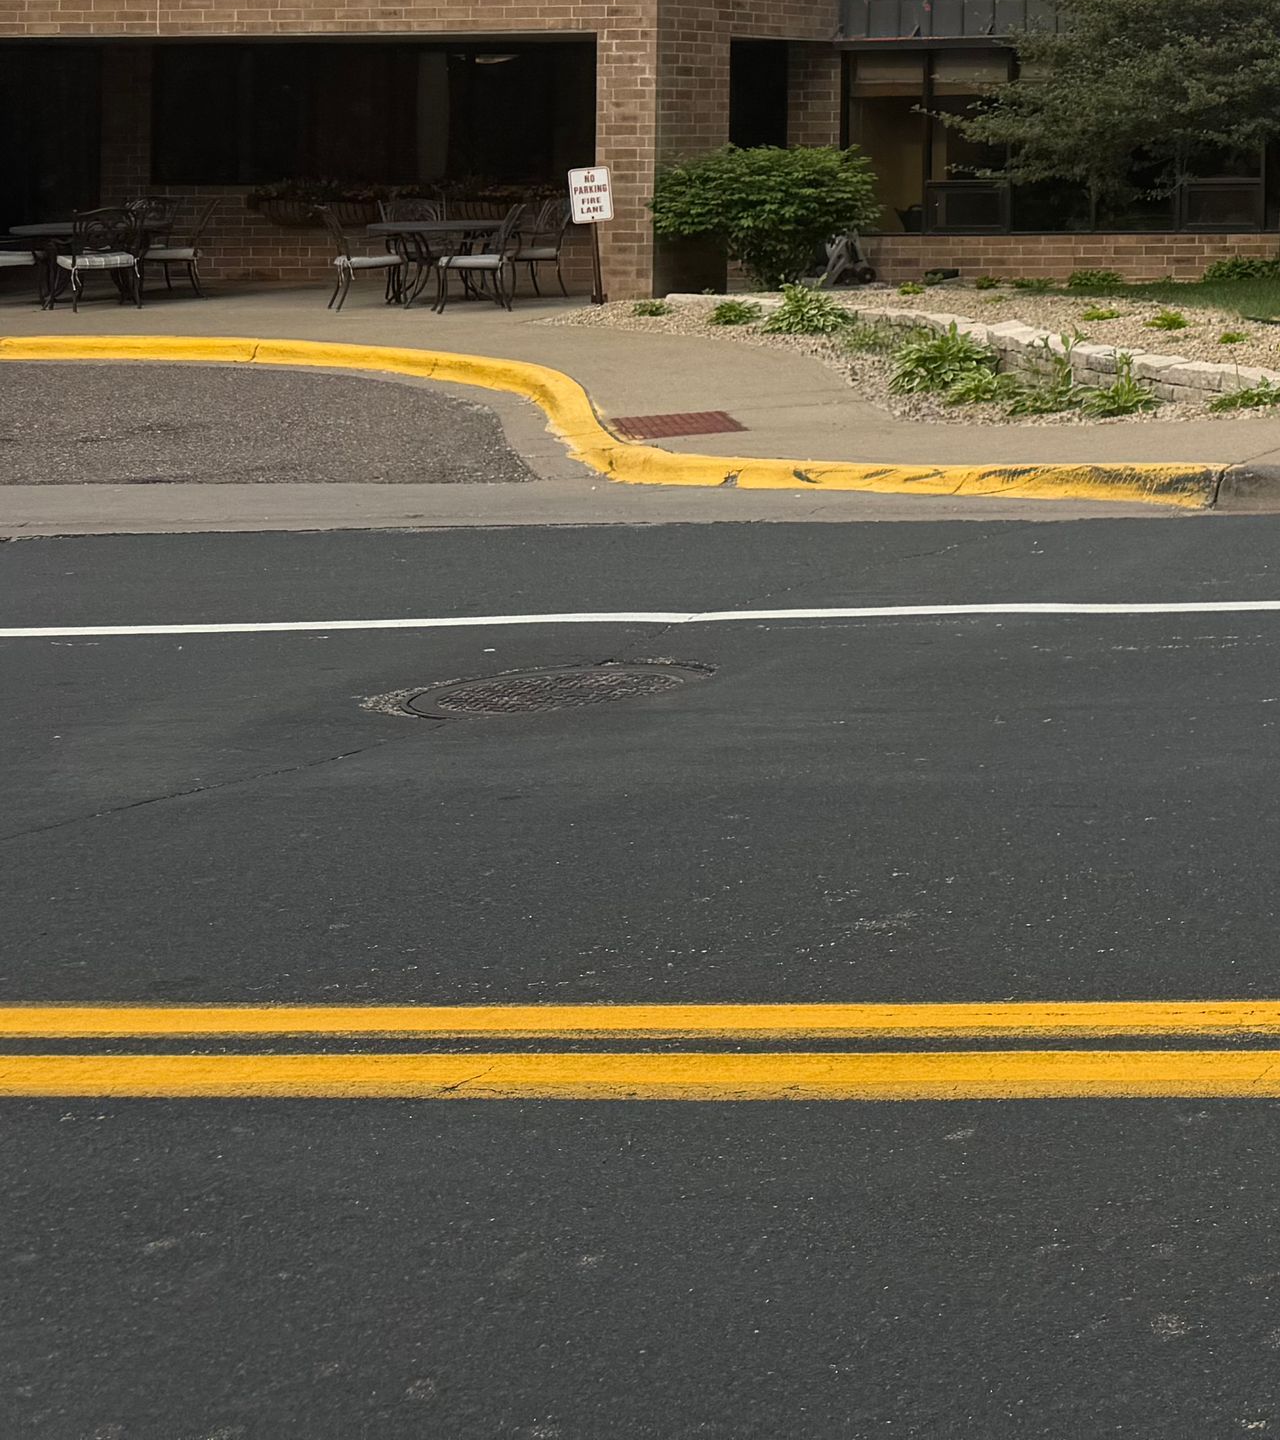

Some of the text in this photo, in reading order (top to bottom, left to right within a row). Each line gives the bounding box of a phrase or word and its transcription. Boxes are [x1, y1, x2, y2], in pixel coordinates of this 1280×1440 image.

[584, 174, 595, 183] NO
[574, 184, 608, 195] PARKING
[582, 196, 601, 205] FIRE
[581, 205, 604, 215] LANE
